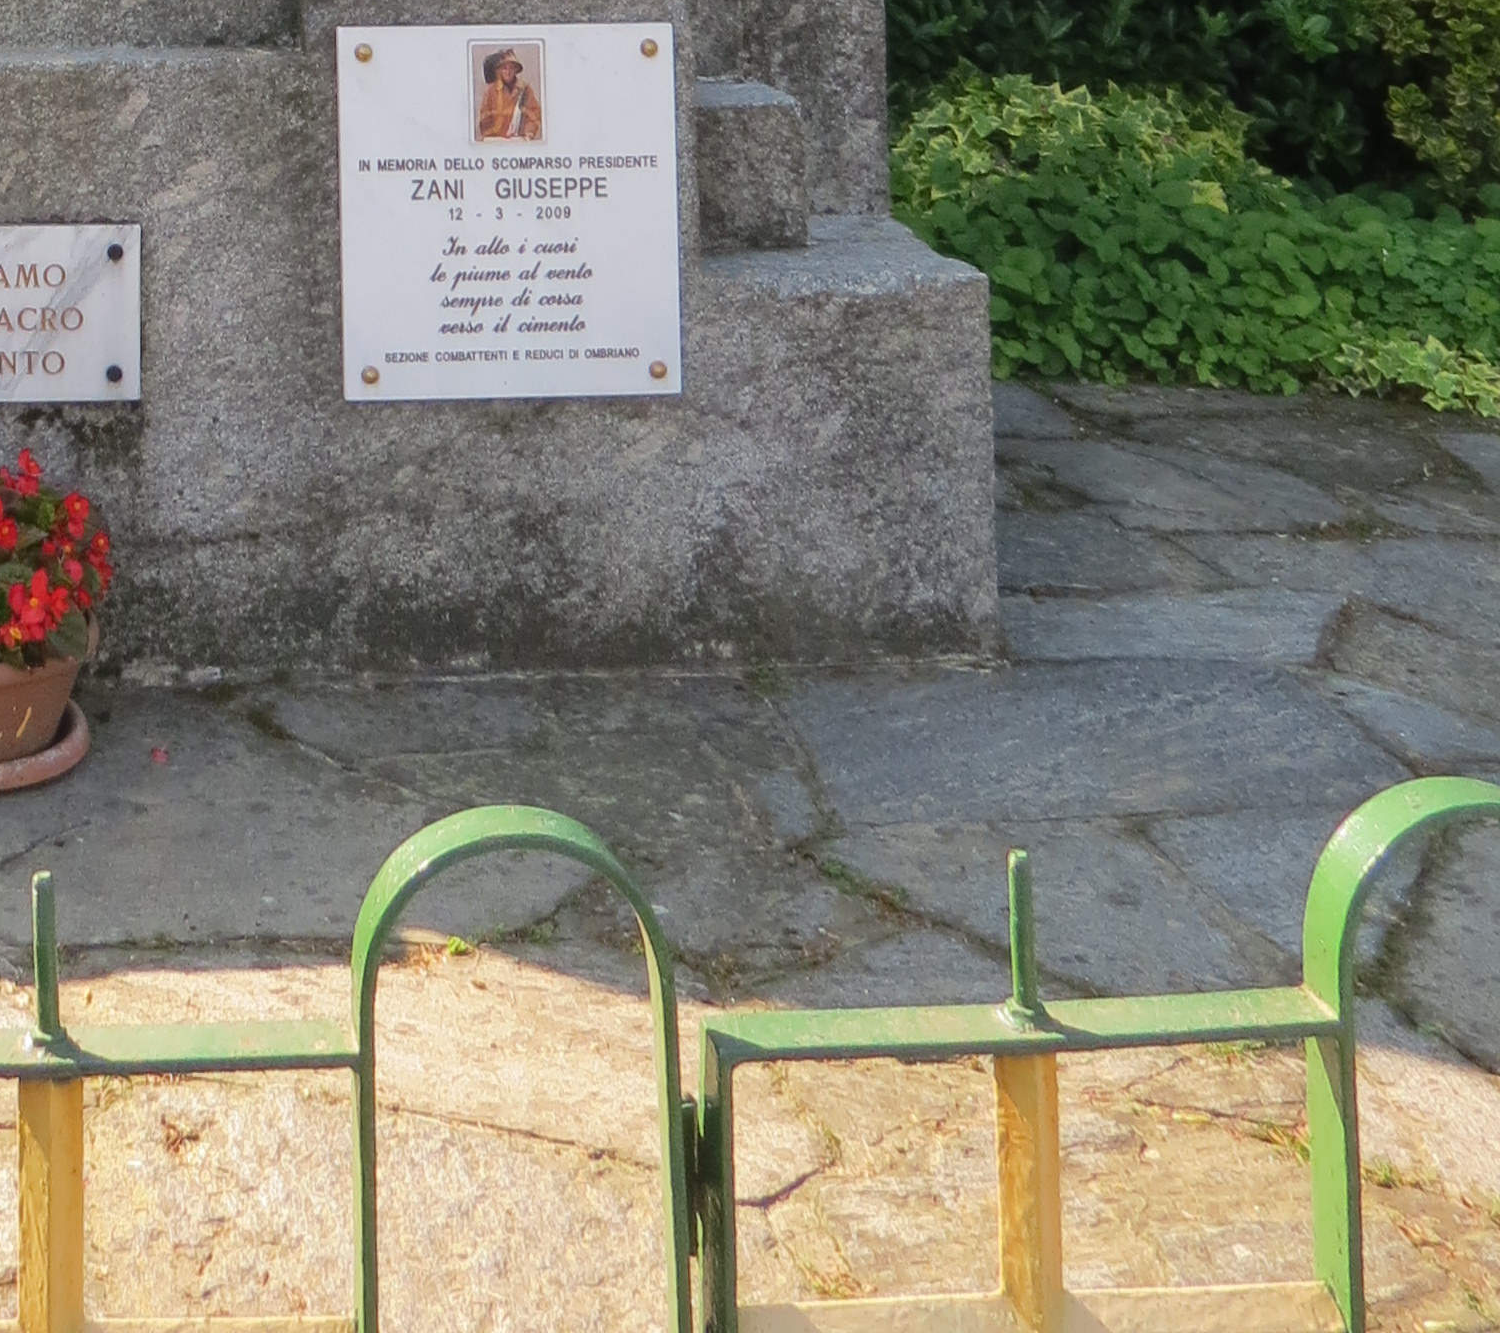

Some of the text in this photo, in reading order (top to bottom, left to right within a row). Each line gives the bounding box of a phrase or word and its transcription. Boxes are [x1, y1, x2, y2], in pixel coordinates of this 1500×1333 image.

[359, 155, 658, 171] IN MEMORIA DELLO SCOMPARSO PRESIDENTE
[411, 177, 608, 200] ZANI GIUSEPPE
[449, 208, 463, 221] 12
[496, 207, 503, 220] 3
[536, 206, 571, 220] 2009
[443, 236, 467, 256] In
[519, 238, 528, 254] i
[533, 237, 578, 254] cuori
[430, 263, 447, 282] le
[452, 266, 511, 291] piume
[519, 261, 541, 281] al
[440, 287, 583, 316] sempre di corsa
[438, 318, 483, 334] verso
[493, 314, 511, 333] il
[385, 348, 640, 363] SEZIONE COMBATTENTI E REDUCI DI OMBRIANO
